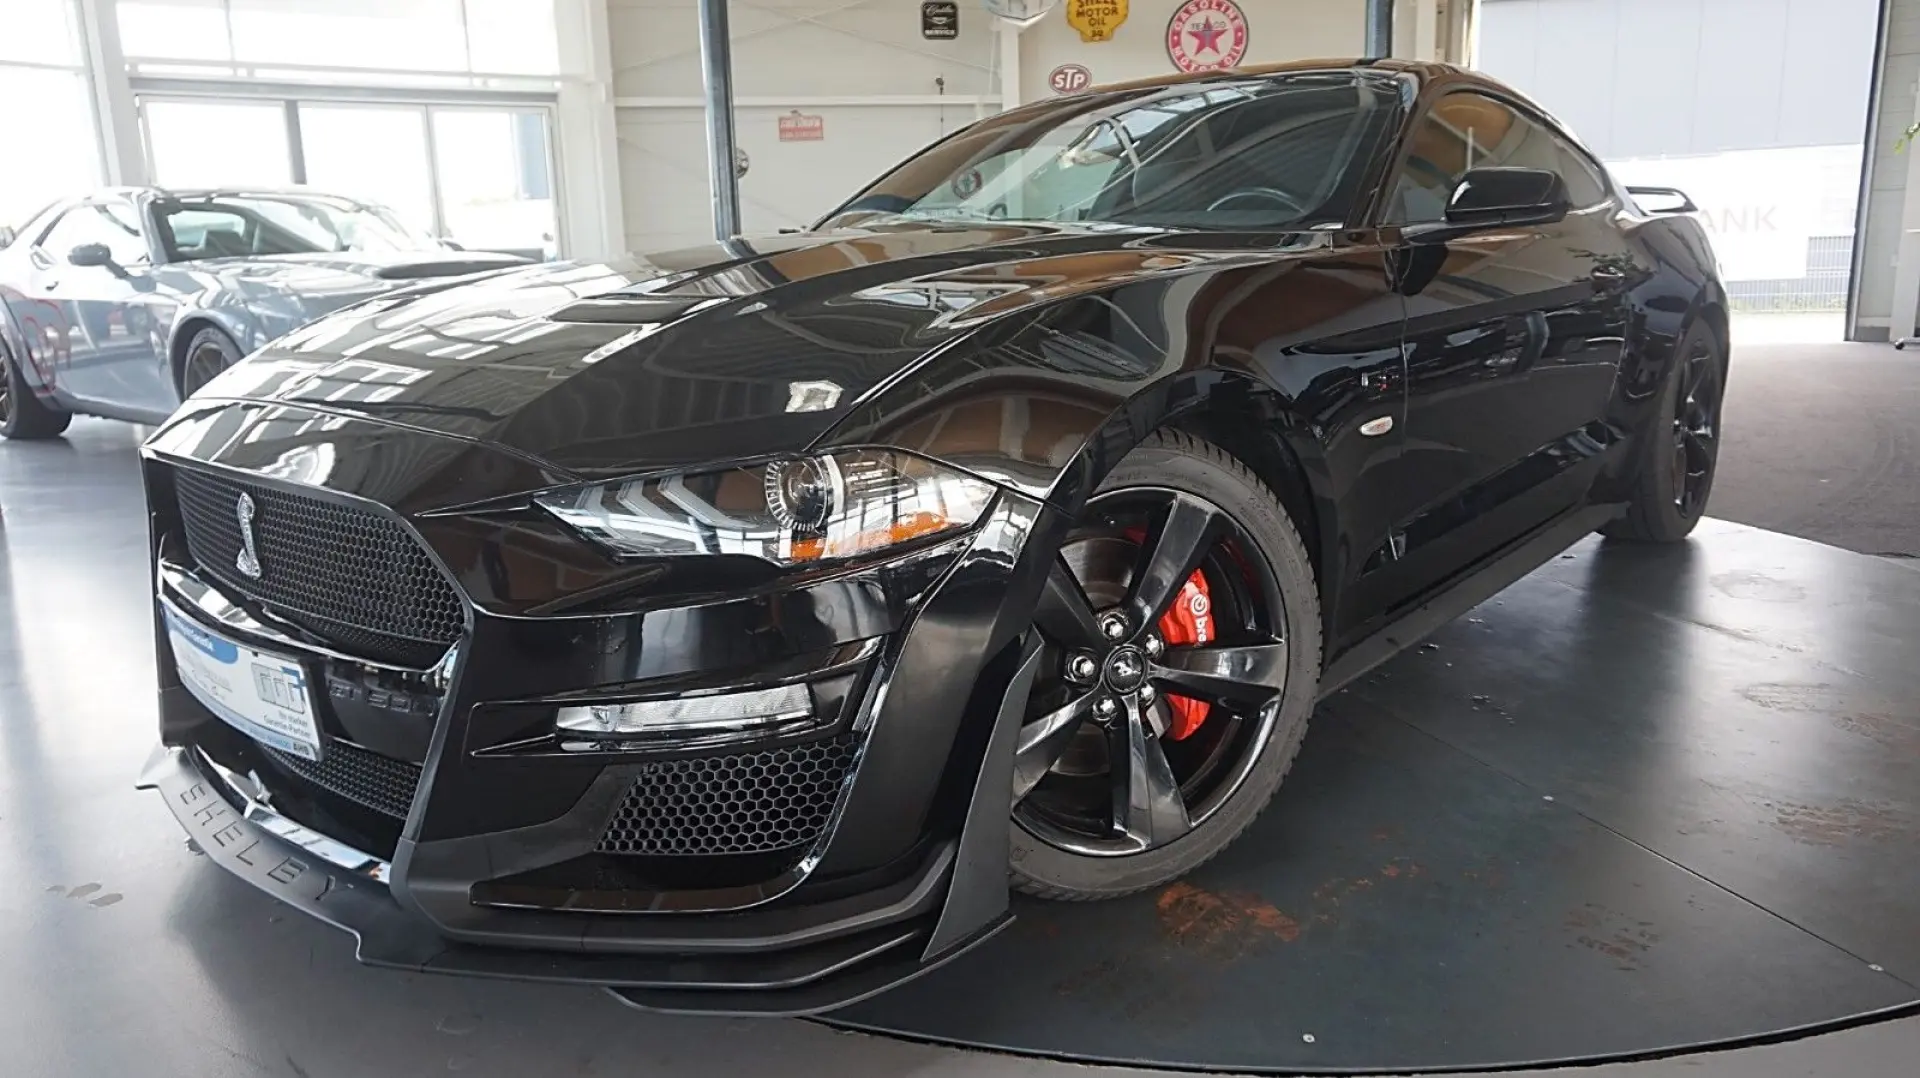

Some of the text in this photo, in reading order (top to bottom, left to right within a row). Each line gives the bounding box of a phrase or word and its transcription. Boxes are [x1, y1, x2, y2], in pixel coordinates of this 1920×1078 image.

[1076, 7, 1119, 17] MOTOR
[1088, 17, 1106, 27] OIL
[1174, 0, 1242, 30] GASOLINE
[1054, 69, 1087, 89] STP
[1700, 204, 1777, 234] ANK
[179, 782, 353, 901] SHELBY
